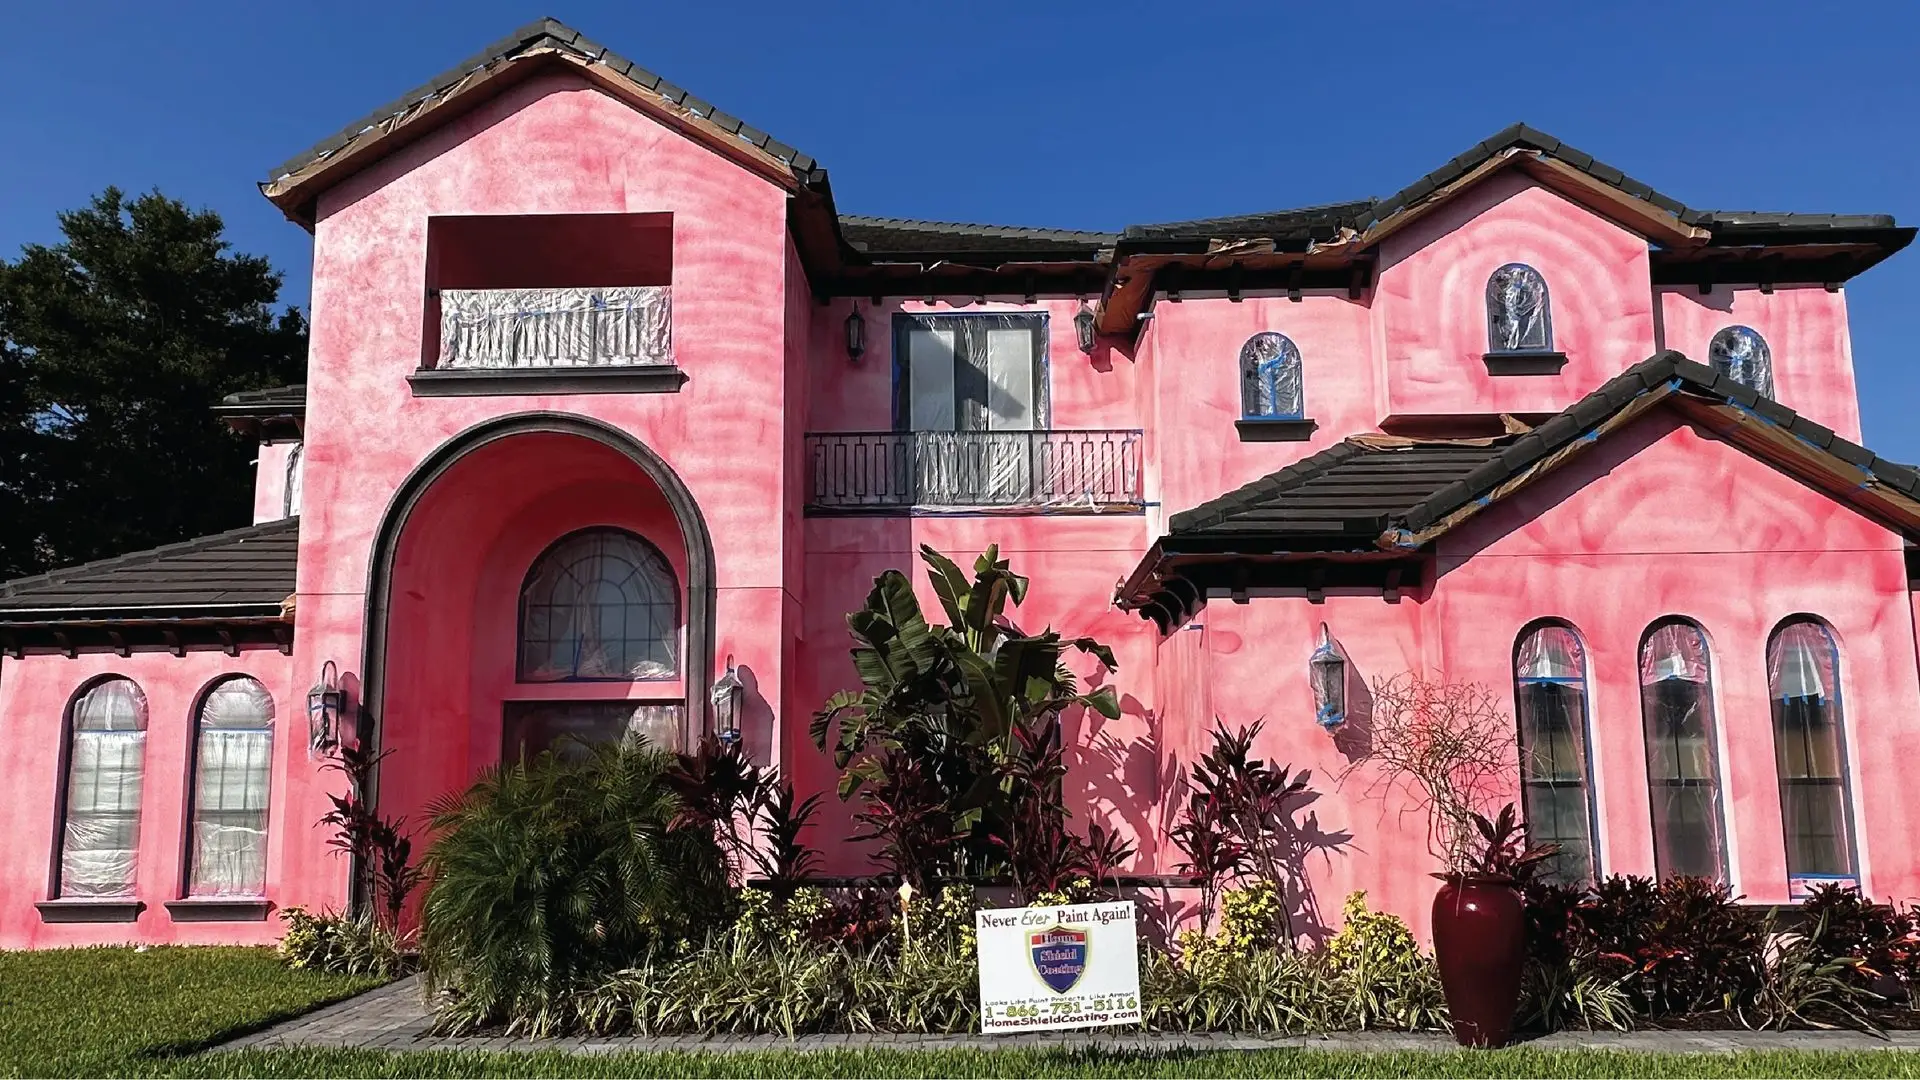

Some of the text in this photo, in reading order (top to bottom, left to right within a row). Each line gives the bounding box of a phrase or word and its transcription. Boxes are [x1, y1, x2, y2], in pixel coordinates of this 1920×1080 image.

[981, 905, 1131, 928] Never Ever Paint Again!
[1040, 948, 1077, 962] Shield
[1039, 963, 1083, 975] Coating
[985, 997, 1138, 1019] 1-866-751-5116
[984, 1010, 1139, 1028] HomeShieldCoating.com
